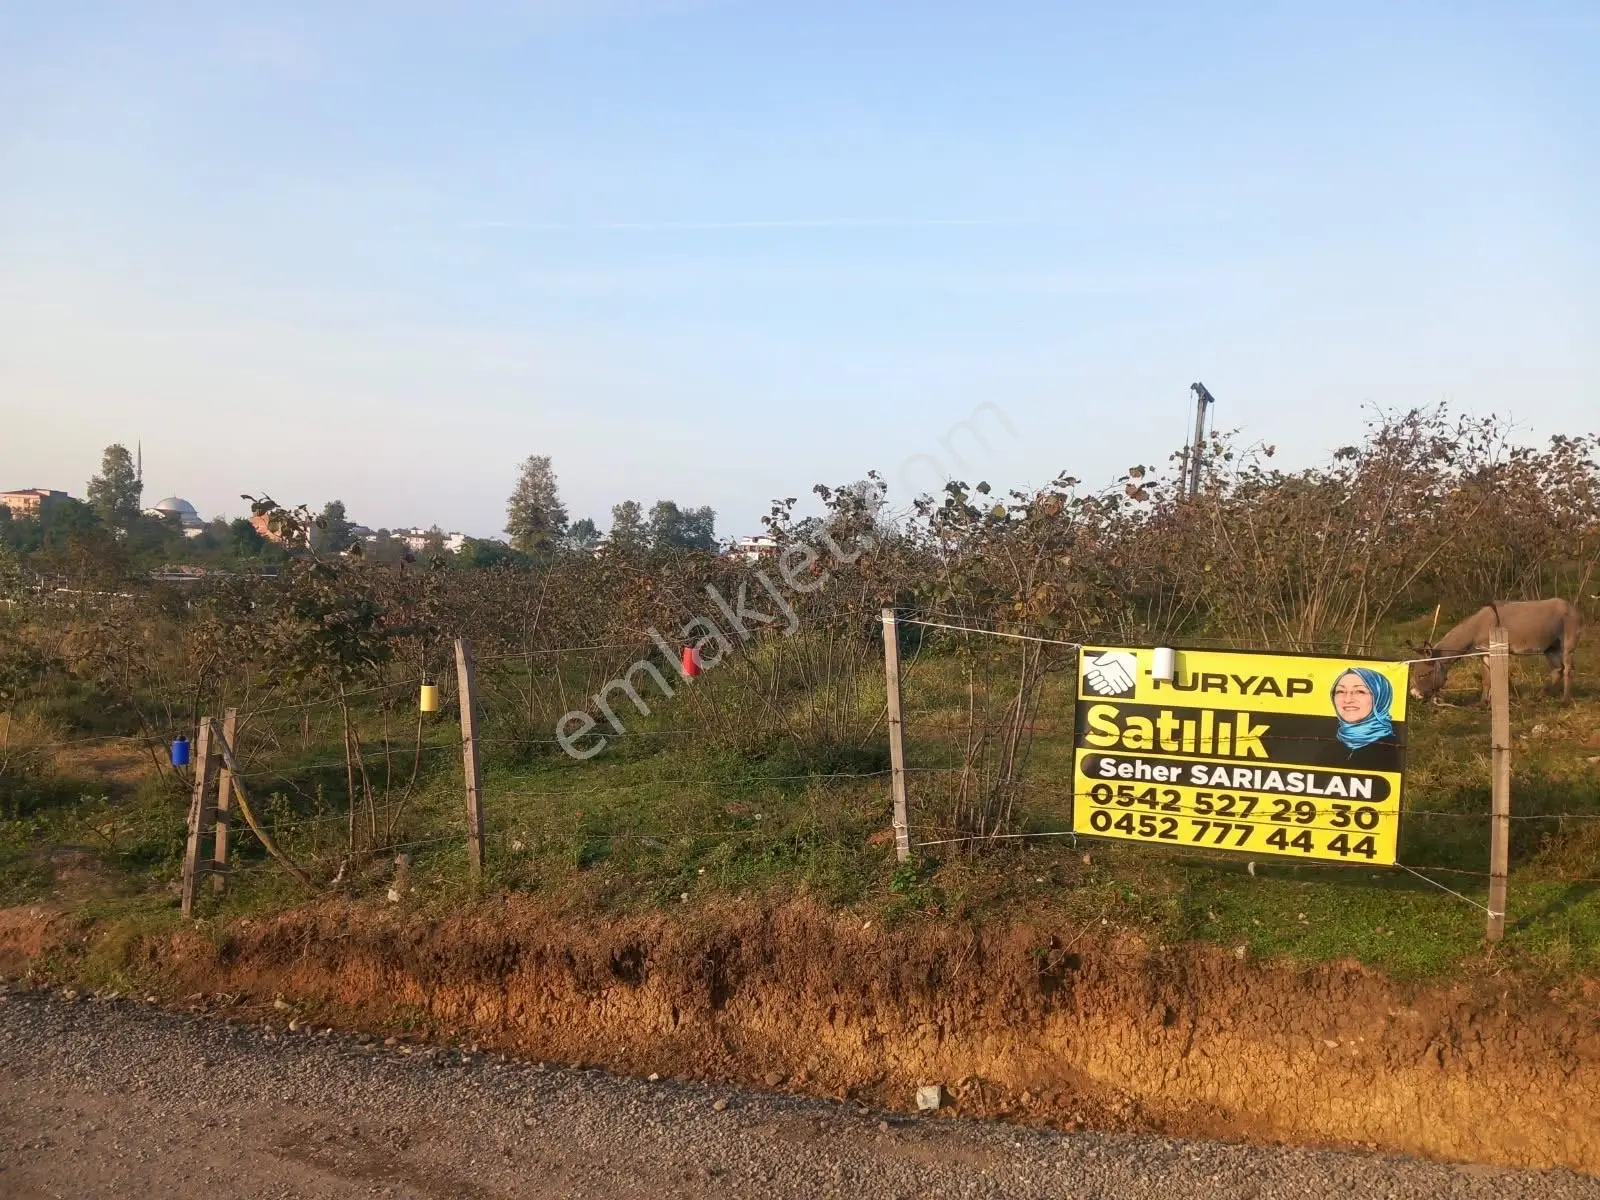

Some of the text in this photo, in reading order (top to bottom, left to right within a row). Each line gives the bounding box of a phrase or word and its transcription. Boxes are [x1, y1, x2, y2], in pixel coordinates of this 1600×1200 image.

[1084, 704, 1271, 759] Satılık
[1098, 757, 1373, 799] Seher SARIASLAN
[1091, 783, 1380, 830] 0542 527 29 30
[1089, 810, 1378, 860] 0452 777 44 44
